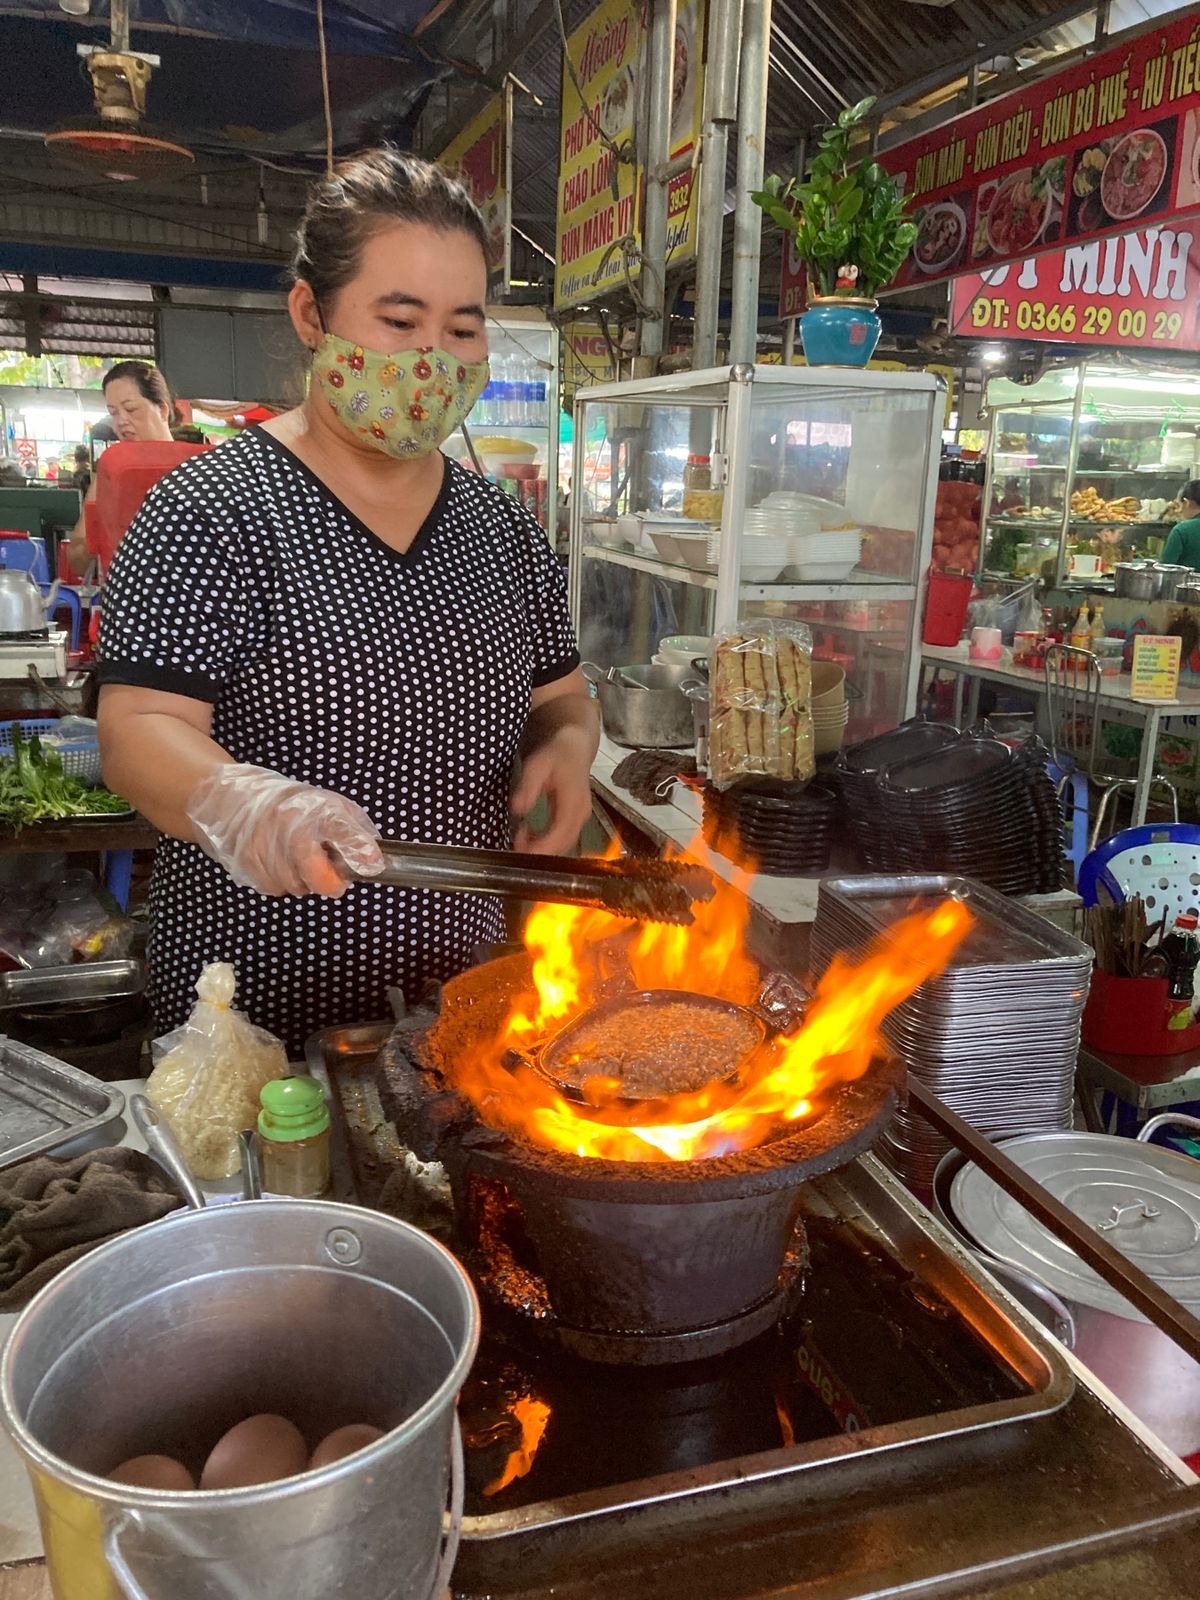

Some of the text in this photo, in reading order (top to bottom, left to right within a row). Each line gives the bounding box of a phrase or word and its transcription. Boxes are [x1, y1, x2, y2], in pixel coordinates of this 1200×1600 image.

[973, 118, 1001, 174] BÚN
[1000, 104, 1032, 163] RIÊU
[1040, 87, 1073, 149] BÚN
[1073, 71, 1097, 136] BÒ
[1096, 52, 1133, 128] HUẾ
[1140, 37, 1168, 111] HỦ
[563, 165, 588, 214] CHÁO
[561, 223, 581, 266] BÚN
[582, 207, 615, 256] MĂNG
[1058, 229, 1194, 300] MINH
[971, 297, 1183, 341] ĐT: 0366 29 00 29
